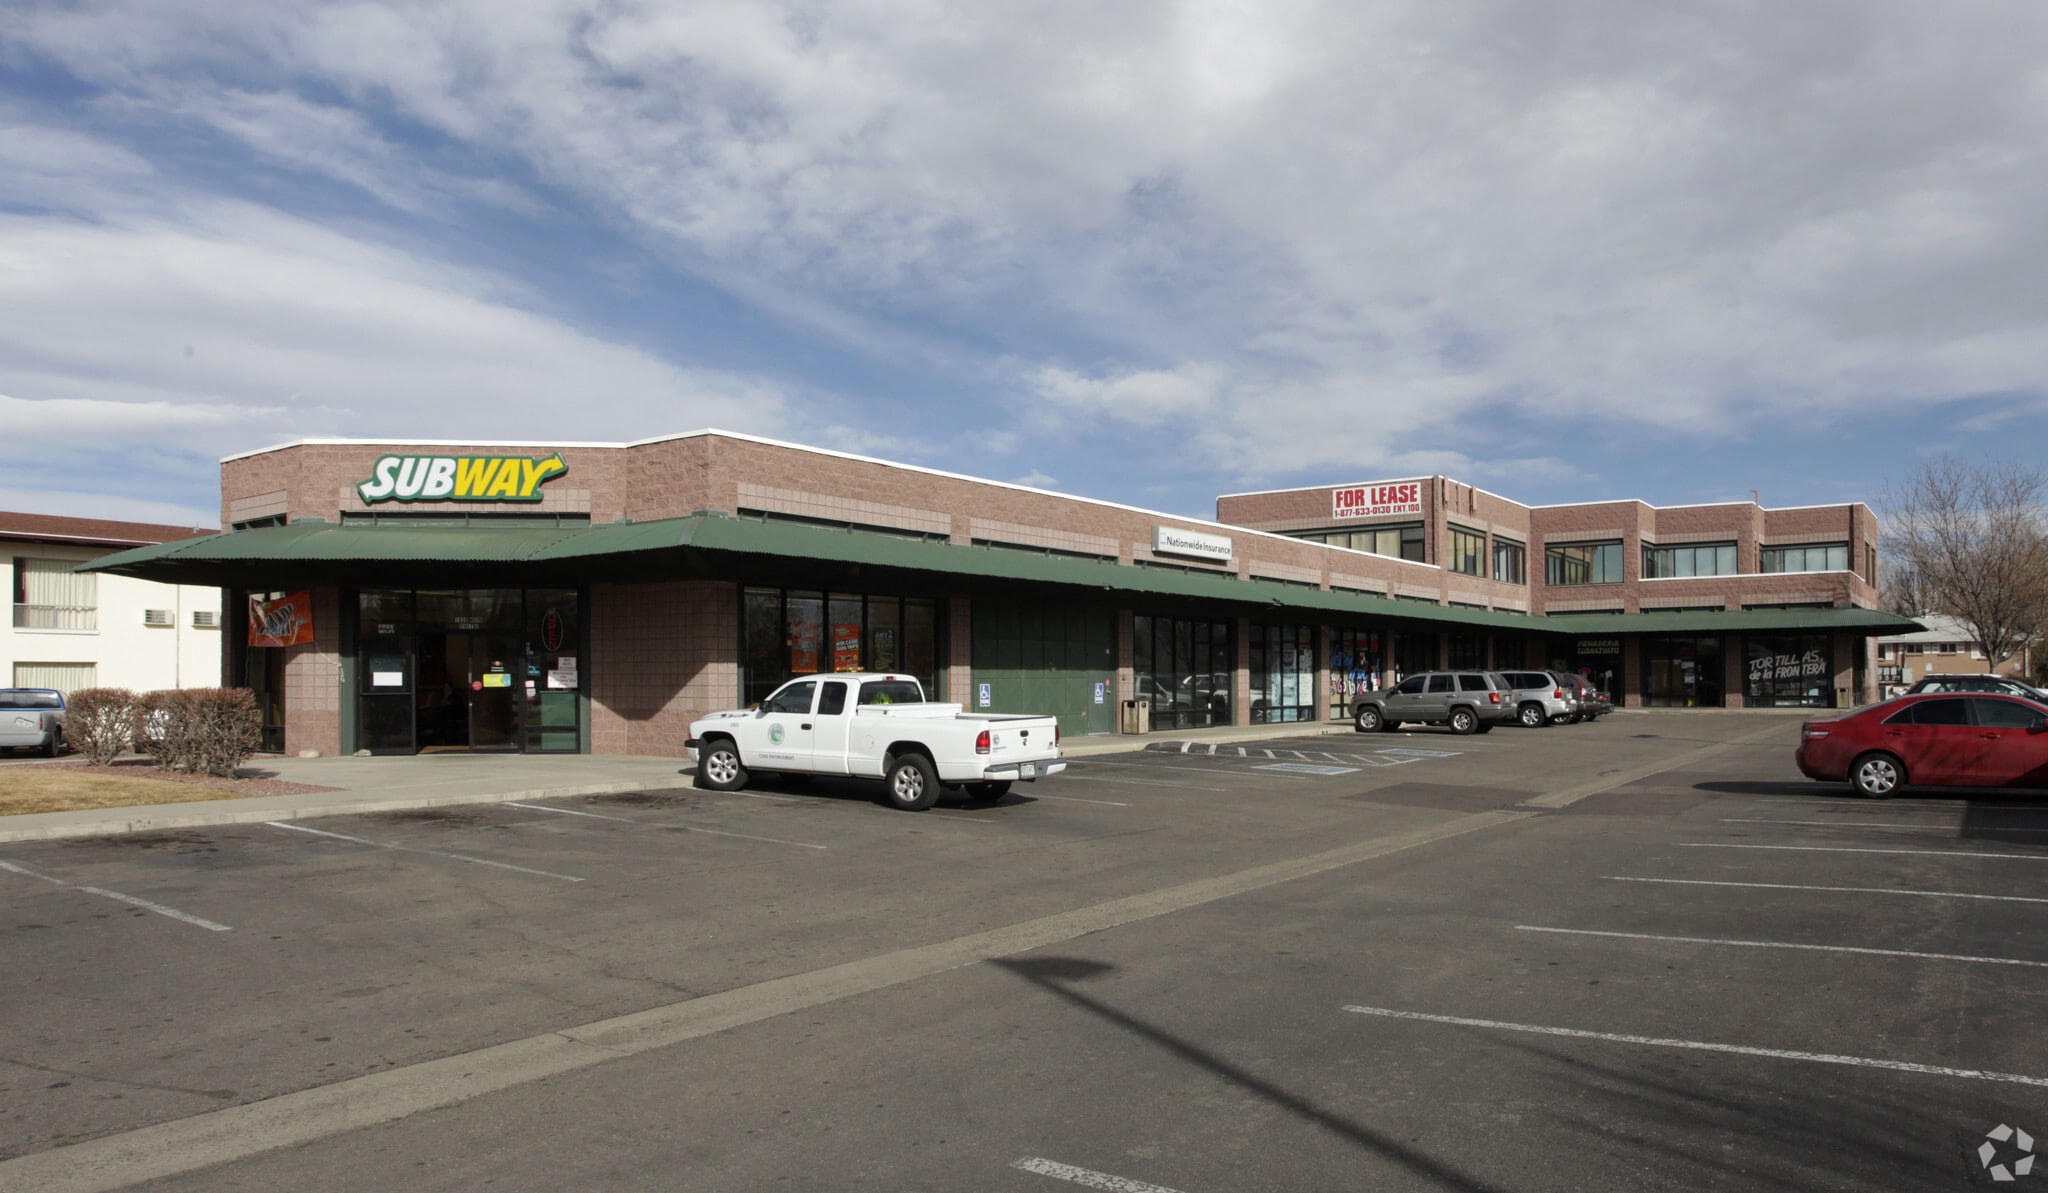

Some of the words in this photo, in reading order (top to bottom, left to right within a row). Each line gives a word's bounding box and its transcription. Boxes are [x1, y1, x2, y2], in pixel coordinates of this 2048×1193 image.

[360, 453, 564, 498] SUBWAY
[1335, 489, 1365, 508] FOR
[1371, 484, 1418, 505] LEASE
[1334, 505, 1391, 517] 1-877-633-0130
[1166, 536, 1203, 550] Nationwide
[1203, 542, 1231, 555] Insurance
